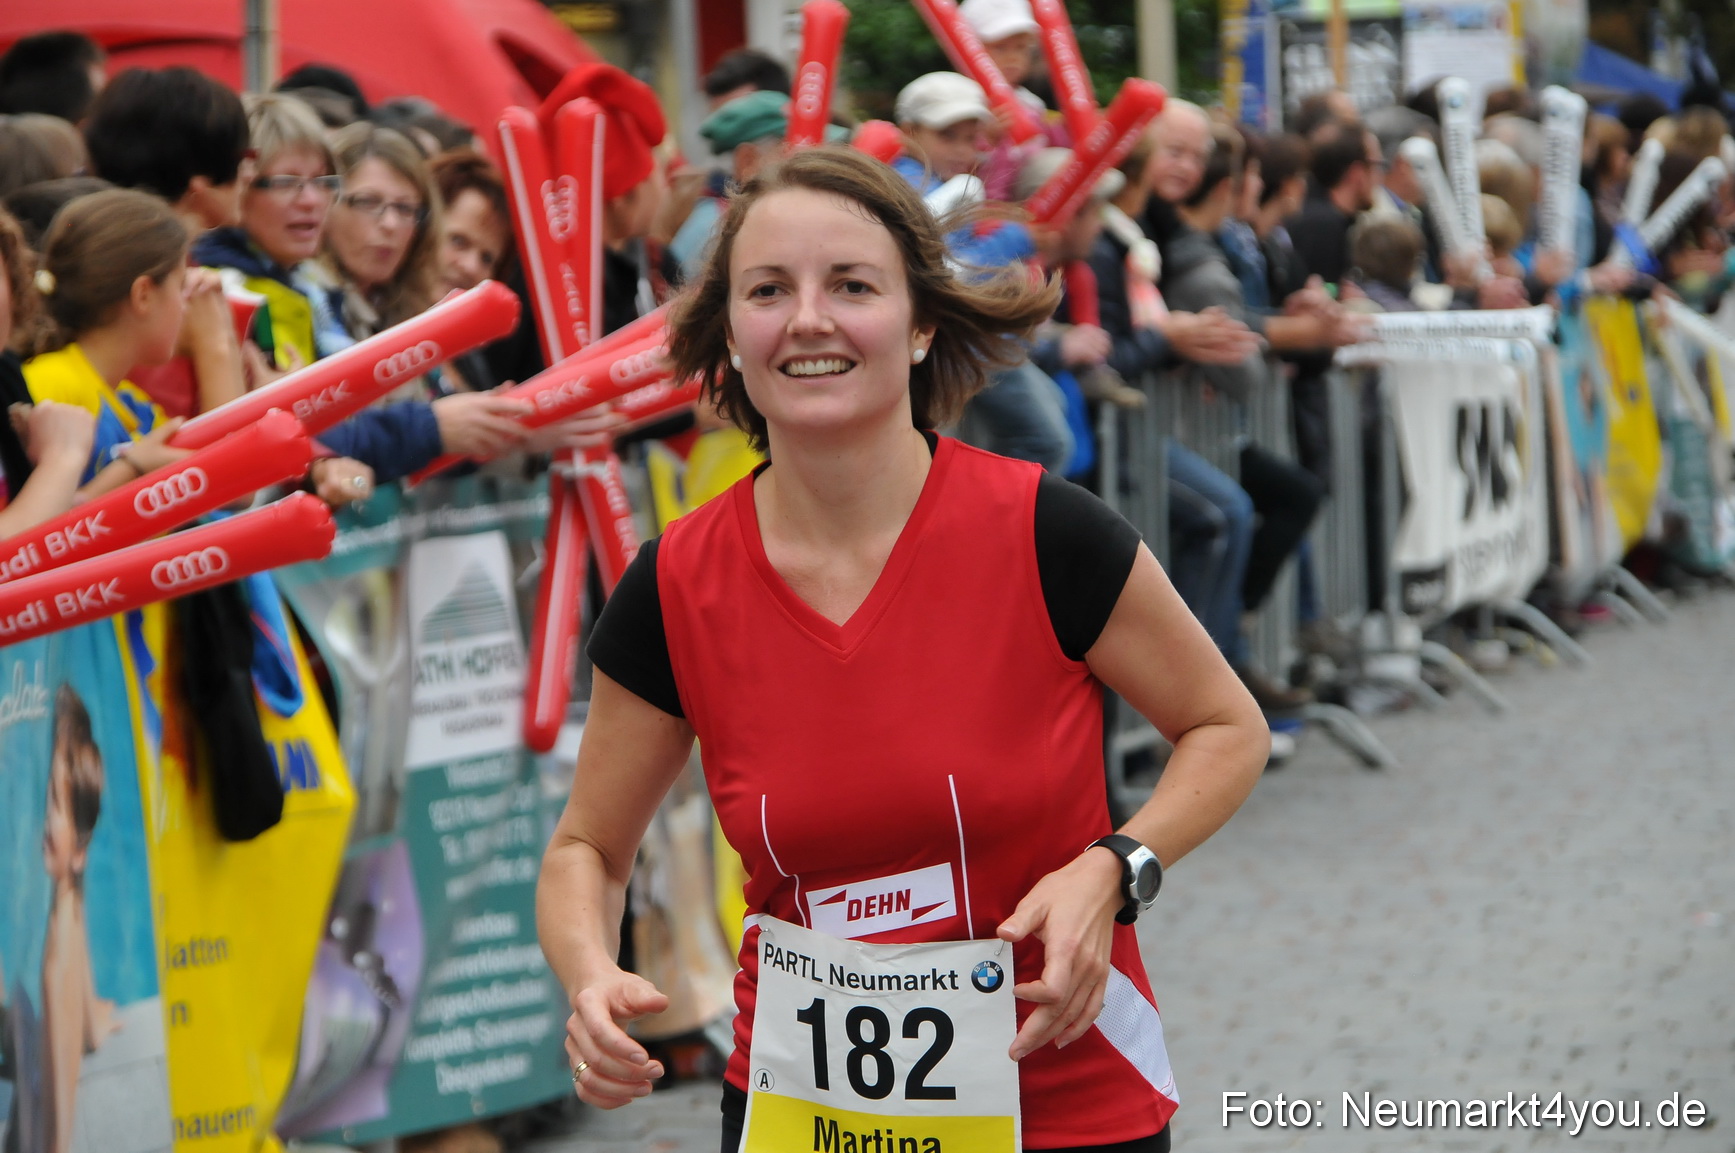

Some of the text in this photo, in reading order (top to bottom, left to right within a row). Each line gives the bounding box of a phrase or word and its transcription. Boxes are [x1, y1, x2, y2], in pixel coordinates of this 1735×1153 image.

[292, 380, 352, 421] BKK
[535, 376, 592, 414] BKK
[0, 510, 112, 581] udi BKK
[0, 577, 125, 635] udi BKK
[846, 889, 911, 922] DEHN
[763, 942, 959, 991] PARTL Neumarkt
[796, 998, 957, 1101] 182
[759, 1072, 769, 1088] A
[813, 1116, 942, 1153] Martina
